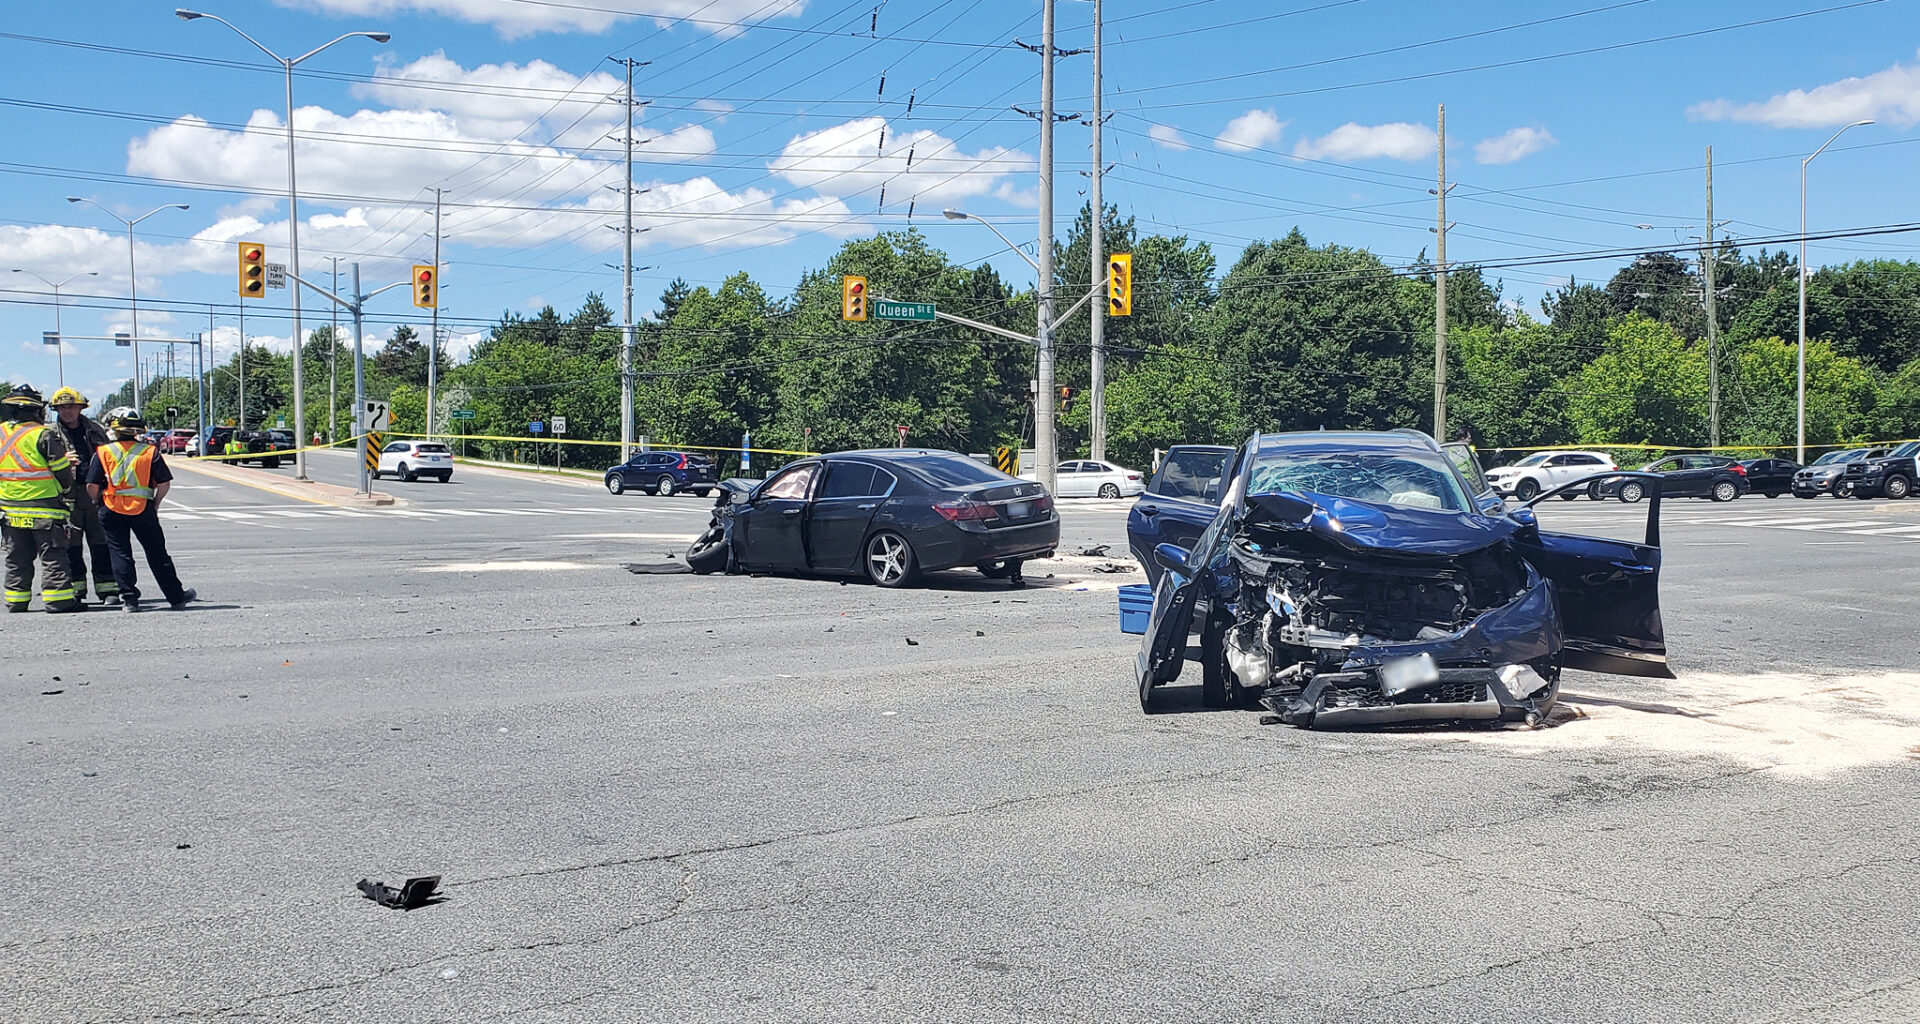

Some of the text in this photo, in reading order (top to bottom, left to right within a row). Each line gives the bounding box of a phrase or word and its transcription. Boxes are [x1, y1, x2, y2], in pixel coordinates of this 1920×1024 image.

[879, 303, 931, 317] Queen St E
[553, 423, 564, 431] 60
